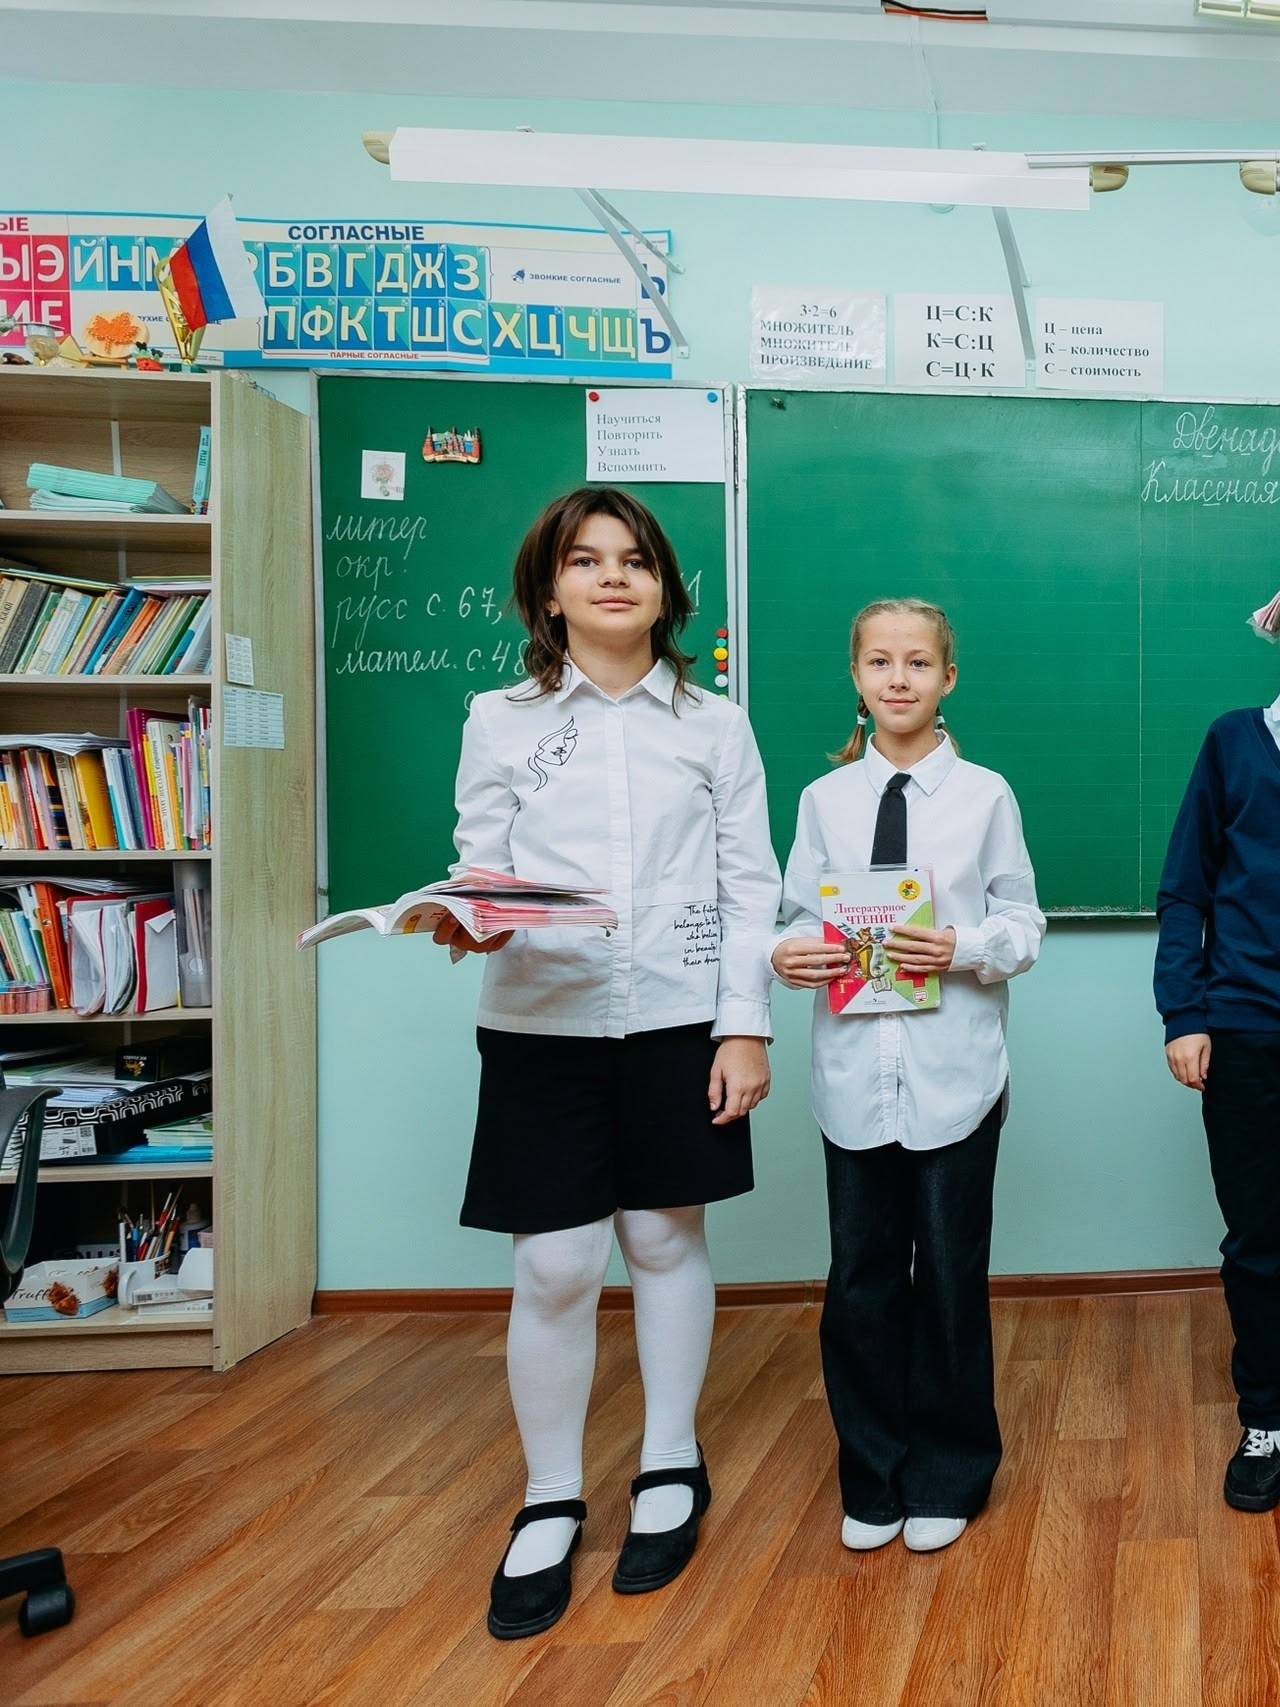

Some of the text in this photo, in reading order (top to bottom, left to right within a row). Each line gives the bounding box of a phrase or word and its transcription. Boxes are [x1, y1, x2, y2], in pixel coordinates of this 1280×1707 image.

[288, 226, 424, 241] СОГЛАСНЫЕ
[529, 273, 621, 284] ЗВОНКИЕ СОГЛАСНЫЕ
[760, 320, 854, 336] МНОЖИТЕЛЬ
[1045, 323, 1103, 336] Ц цена
[761, 337, 854, 352] МНОЖИТЕЛЬ
[1045, 342, 1149, 357] К количество
[330, 351, 419, 360] ПАРНЫЕ СОГЛАСНЫЕ
[761, 354, 873, 370] ПРОИЗВЕДЕНИЕ
[1044, 362, 1141, 377] С стоимость
[596, 412, 662, 427] Научиться
[596, 428, 663, 443] Повторить
[597, 444, 641, 459] Узнать
[597, 460, 667, 474] Вспомнить
[1140, 459, 1280, 504] Классная
[834, 903, 906, 915] Литературное
[846, 914, 897, 925] ЧТЕНИЕ
